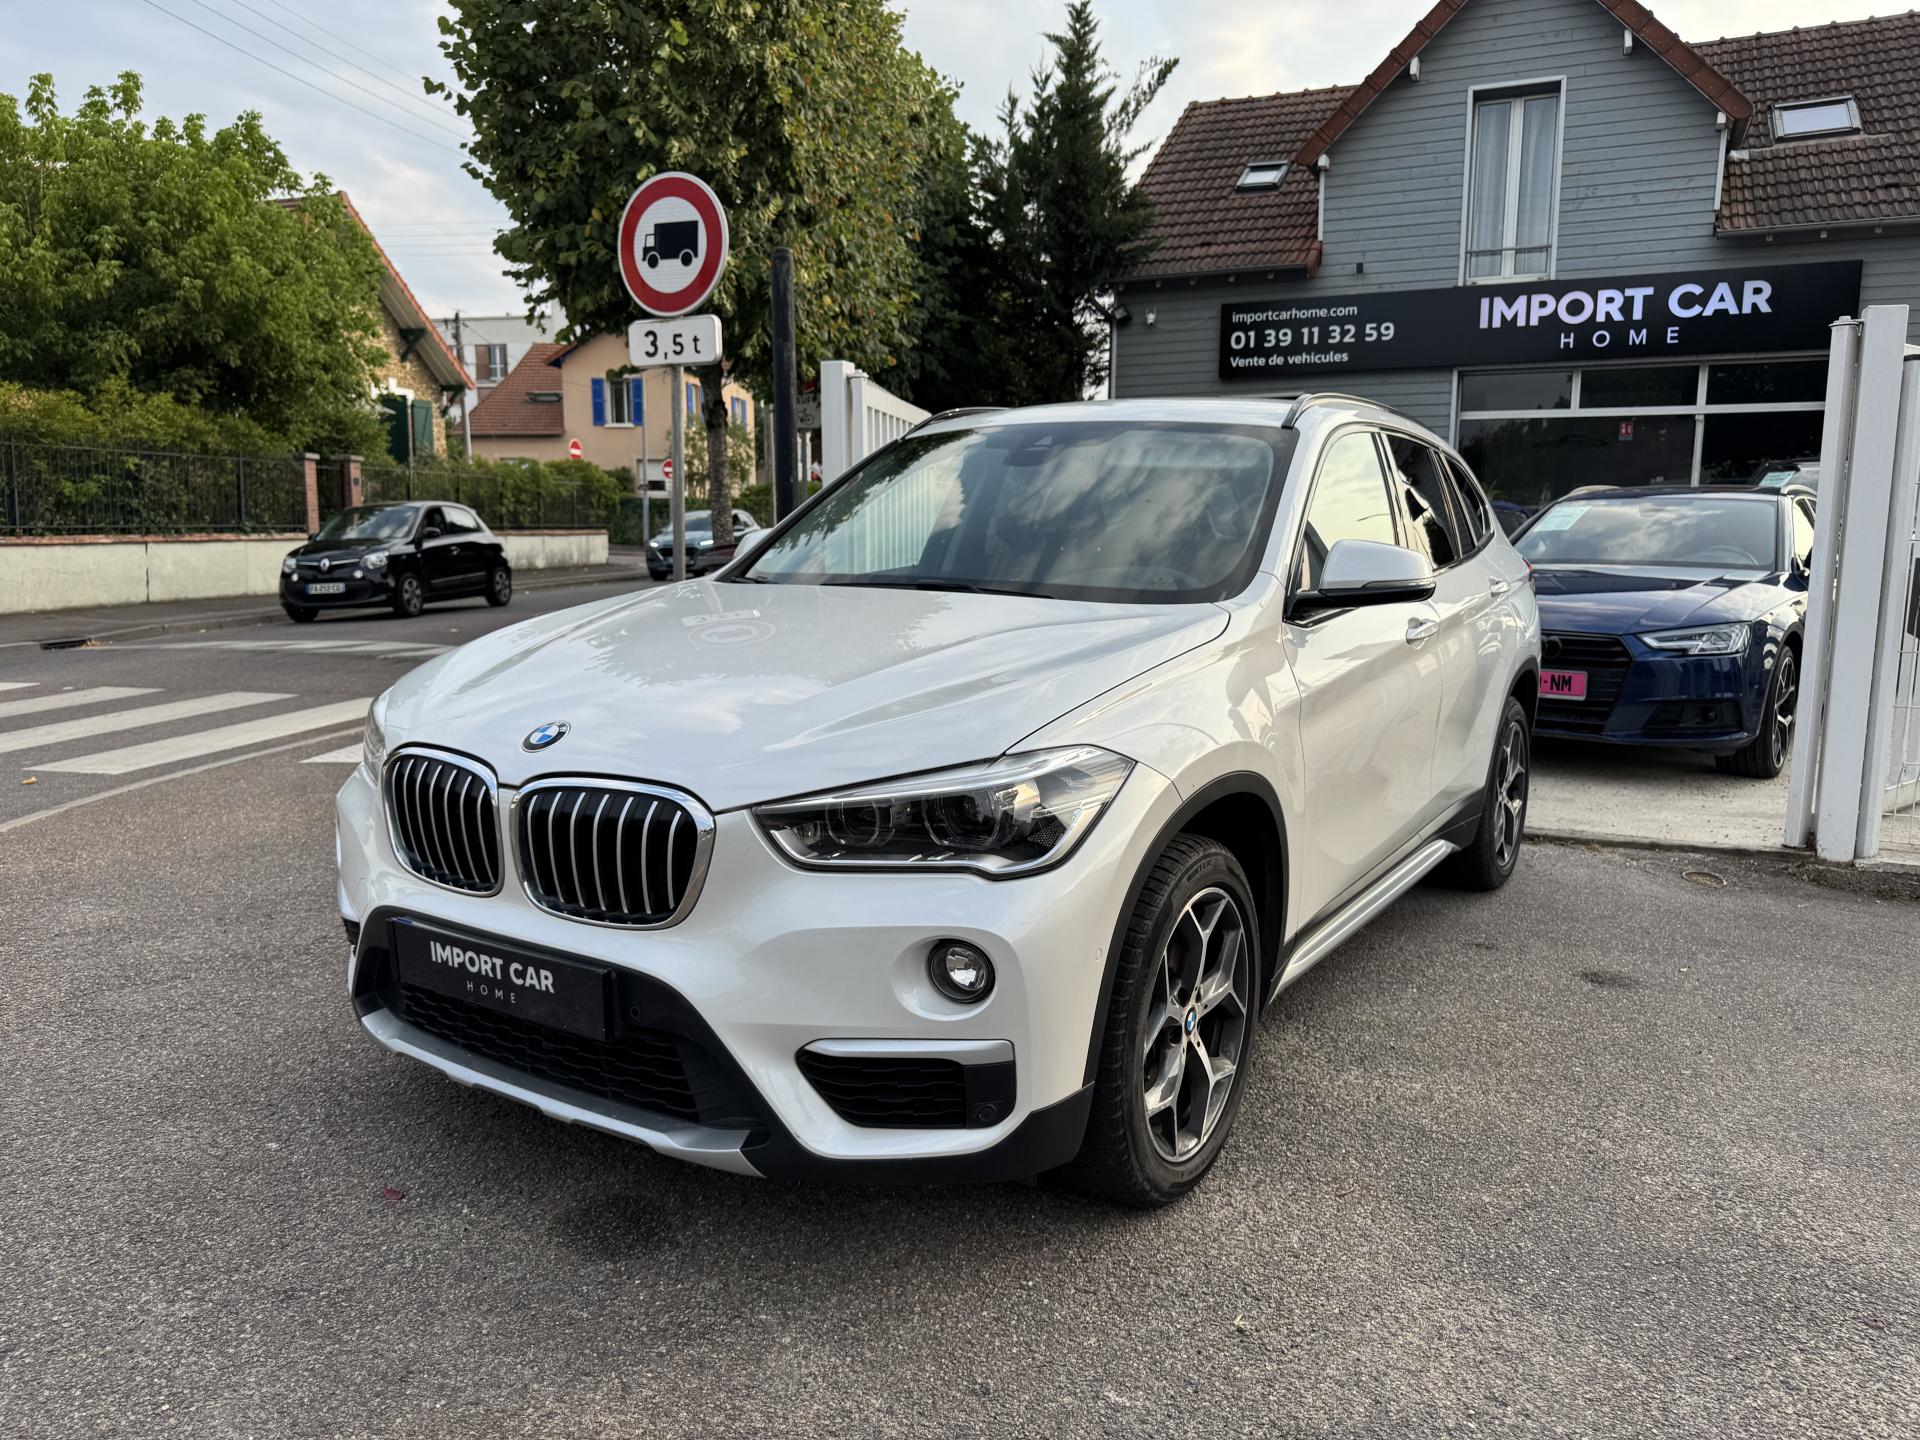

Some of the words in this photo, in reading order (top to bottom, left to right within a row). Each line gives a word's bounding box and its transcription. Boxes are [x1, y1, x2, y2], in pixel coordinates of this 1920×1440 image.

[1232, 306, 1358, 325] importcarhome.com
[1479, 286, 1655, 329] IMPORT
[1668, 279, 1773, 318] CAR
[644, 330, 685, 360] 3,5
[692, 335, 702, 354] t
[1230, 330, 1256, 350] 01
[1263, 328, 1293, 348] 39
[1301, 326, 1320, 345] 11
[1327, 324, 1356, 344] 32
[1364, 322, 1395, 342] 59
[1560, 326, 1680, 349] HOME
[1230, 356, 1266, 368] Vente
[1268, 354, 1284, 366] de
[1287, 351, 1349, 364] vehicules
[430, 940, 504, 980] IMPORT
[509, 962, 555, 994] CAR
[467, 980, 517, 1004] HOME
